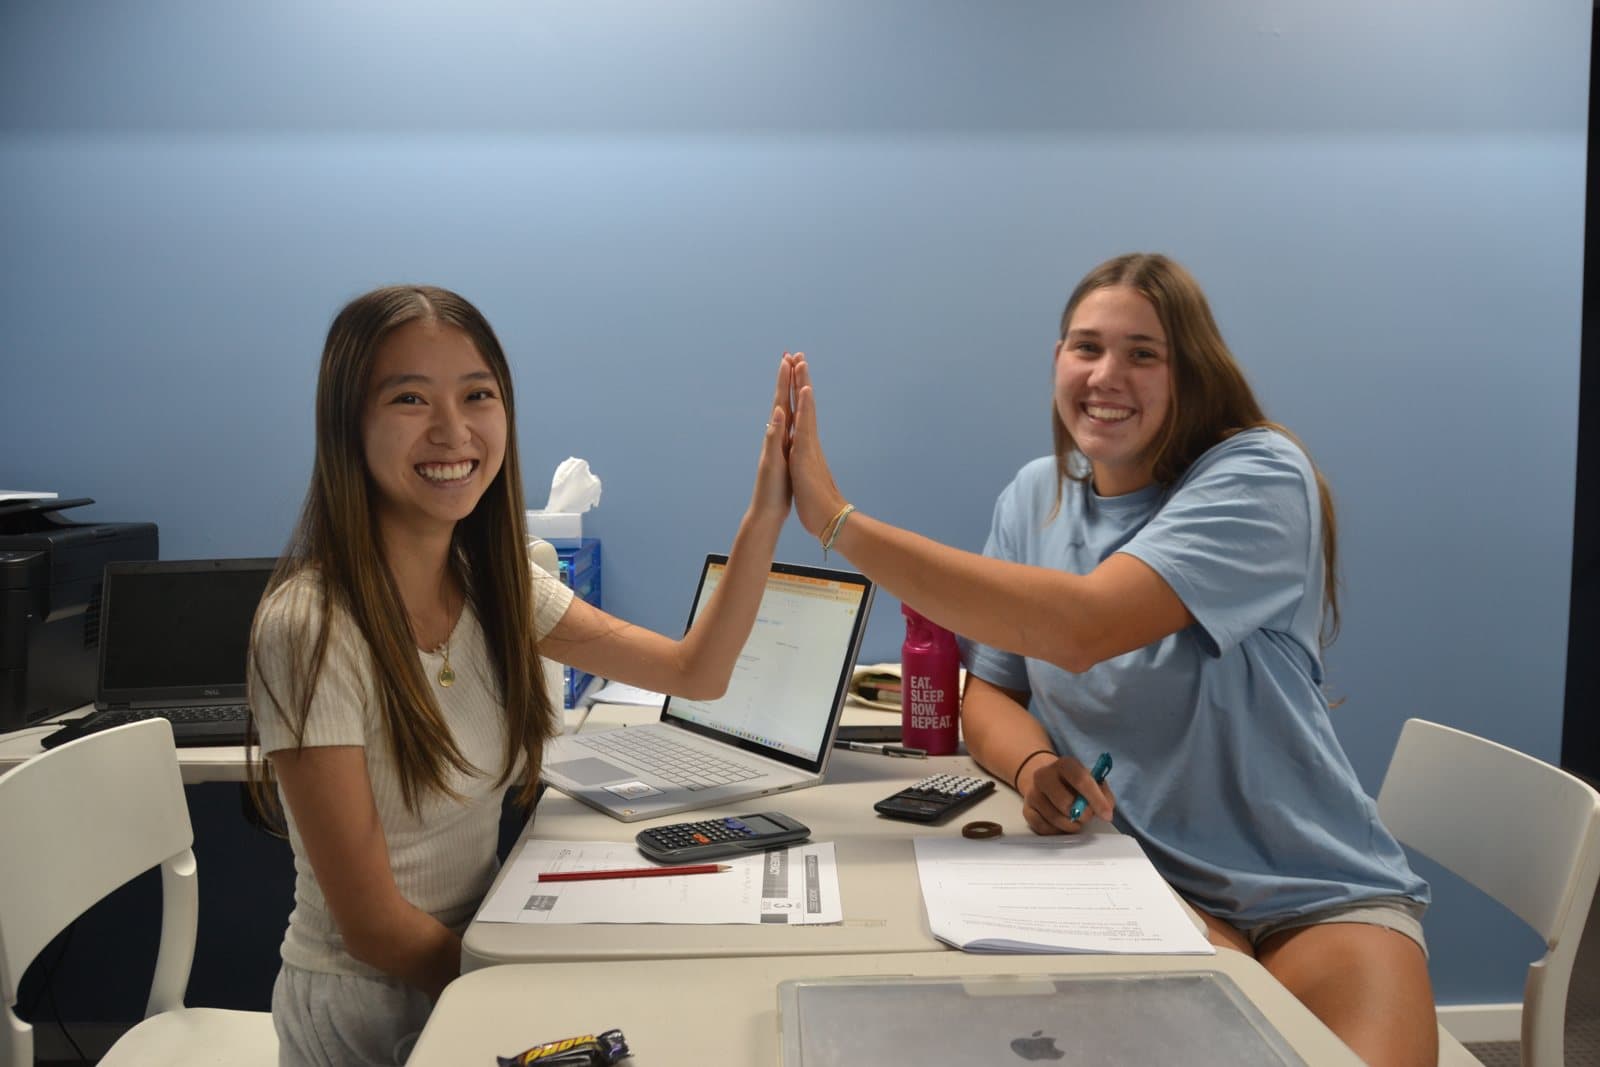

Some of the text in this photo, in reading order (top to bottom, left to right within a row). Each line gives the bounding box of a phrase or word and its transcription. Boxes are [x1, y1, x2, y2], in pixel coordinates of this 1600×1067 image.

[911, 676, 932, 689] EAT.
[911, 690, 944, 703] SLEEP.
[912, 703, 937, 716] ROW.
[912, 715, 953, 729] REPEAT.
